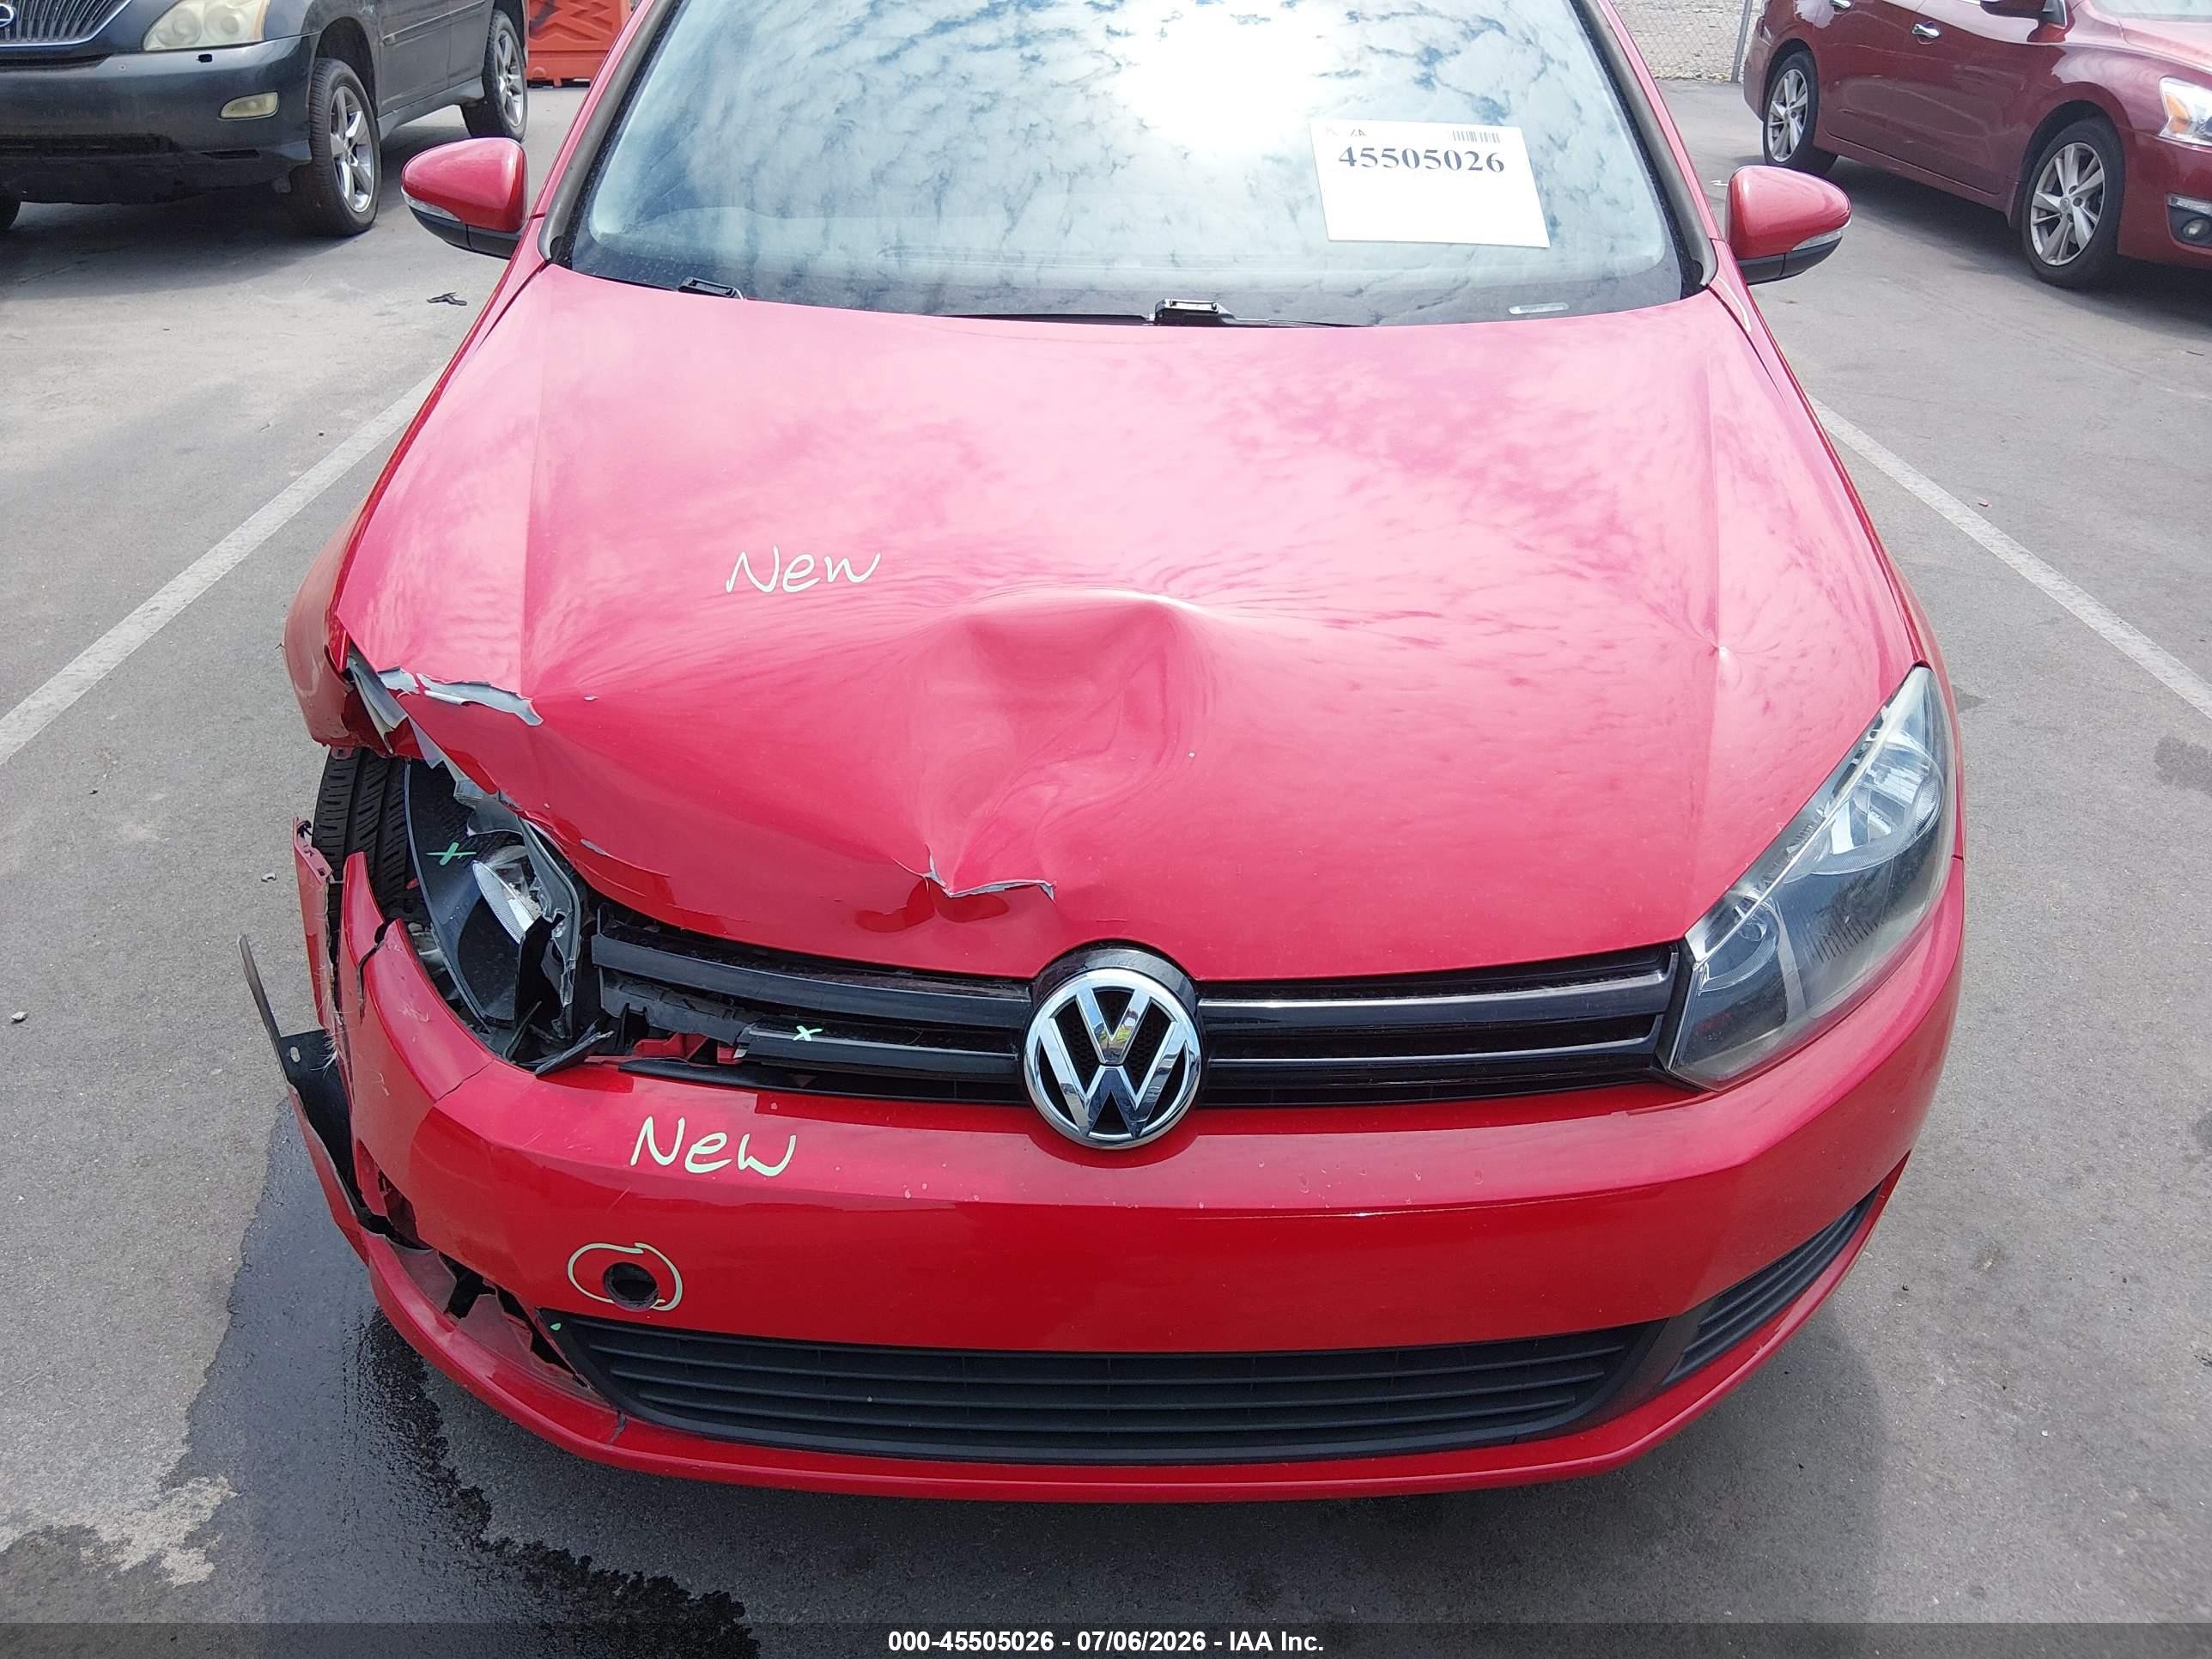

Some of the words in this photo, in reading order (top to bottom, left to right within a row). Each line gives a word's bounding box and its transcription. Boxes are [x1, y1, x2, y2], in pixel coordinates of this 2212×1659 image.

[1338, 146, 1504, 173] 45505026
[726, 545, 882, 593] New
[1028, 975, 1197, 1144] VW
[629, 1115, 797, 1177] New
